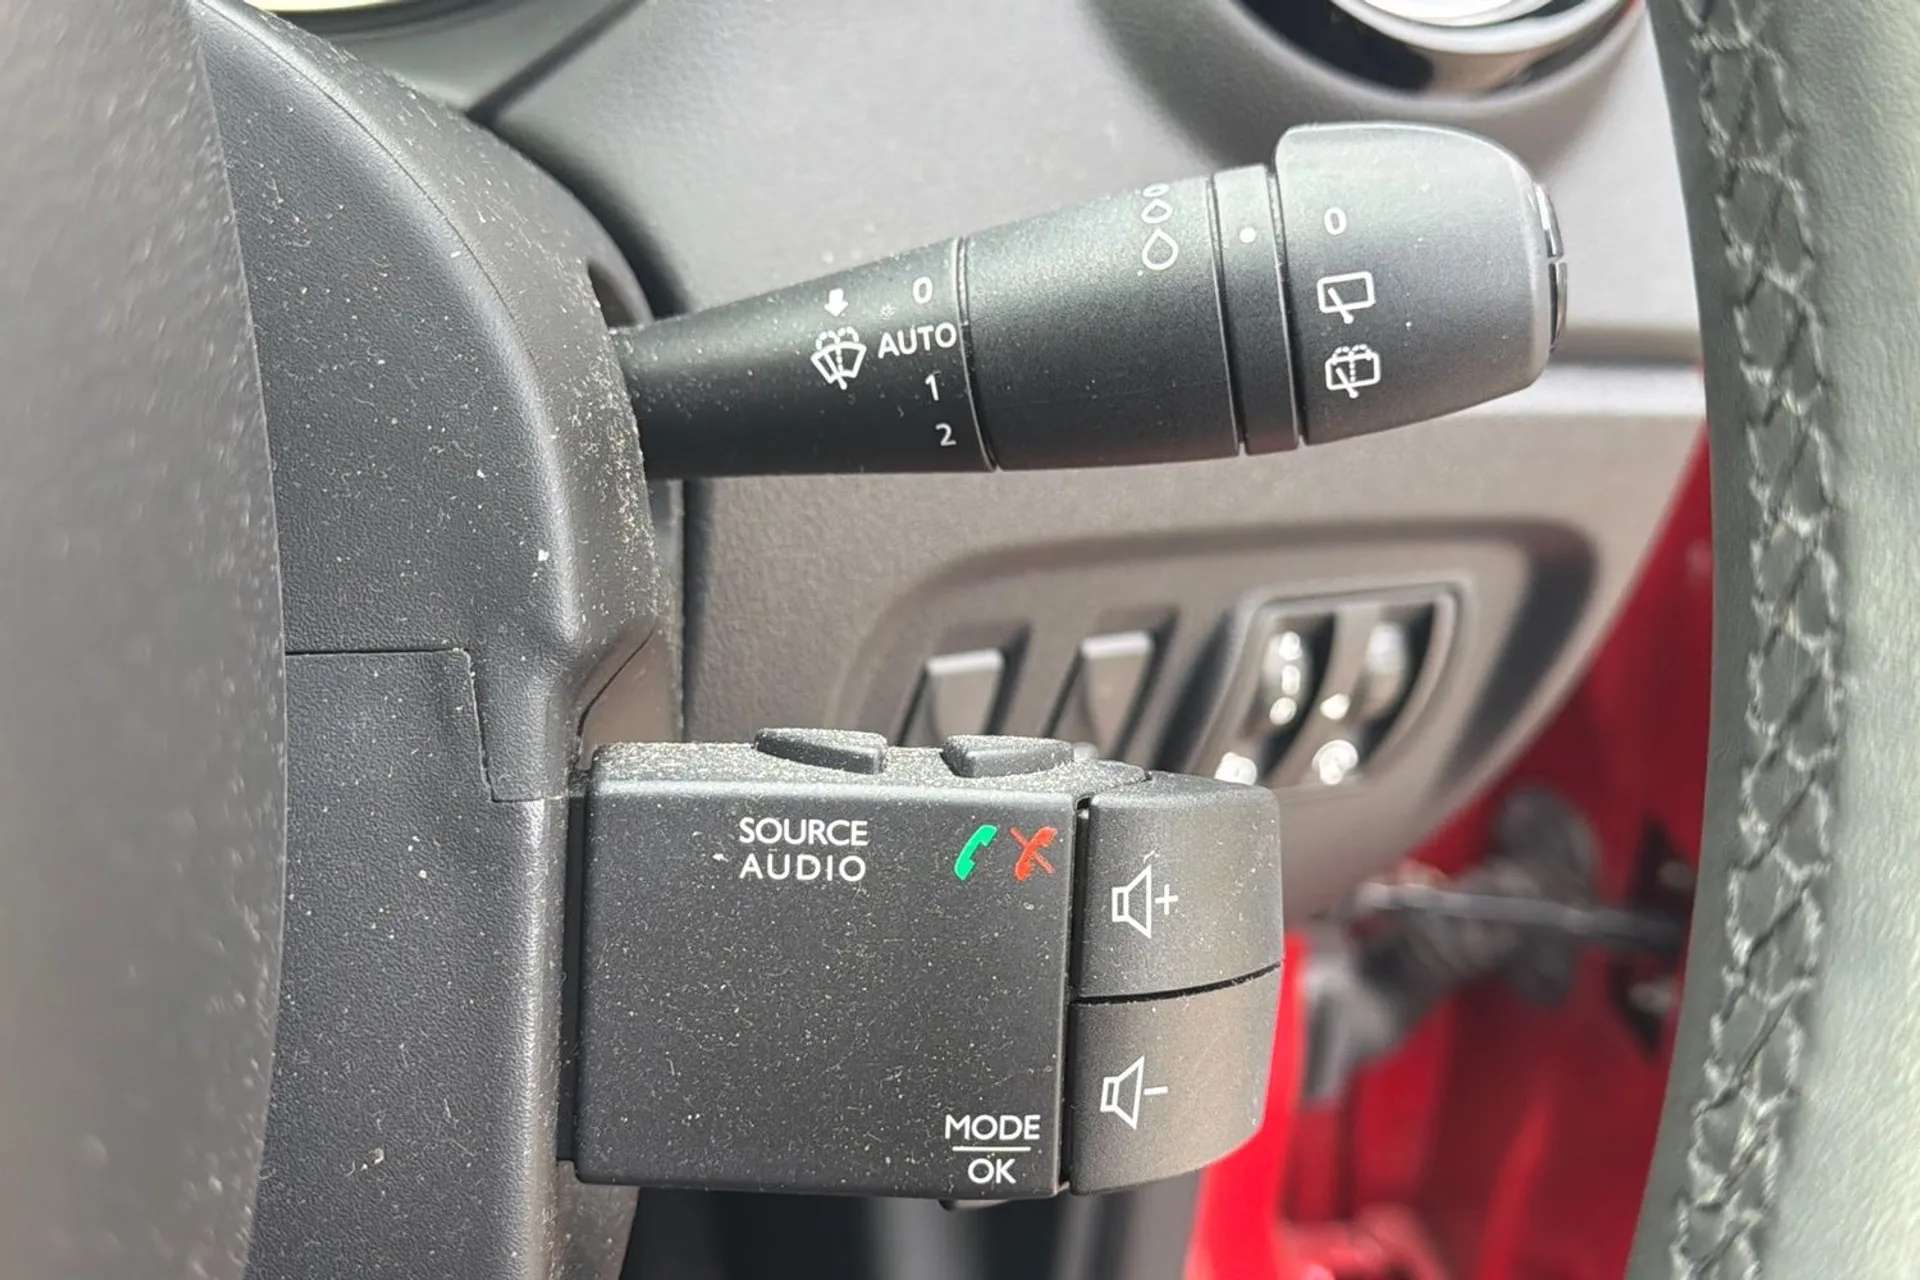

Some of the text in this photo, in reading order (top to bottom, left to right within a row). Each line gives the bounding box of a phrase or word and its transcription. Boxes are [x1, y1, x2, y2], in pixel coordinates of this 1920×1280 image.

[912, 276, 933, 304] 0
[877, 322, 957, 359] AUTO
[925, 373, 940, 401] 1
[935, 423, 957, 446] 2
[739, 816, 869, 847] SOURCE
[739, 853, 866, 882] AUDIO
[944, 1114, 1041, 1140] MODE
[967, 1158, 1017, 1184] OK
